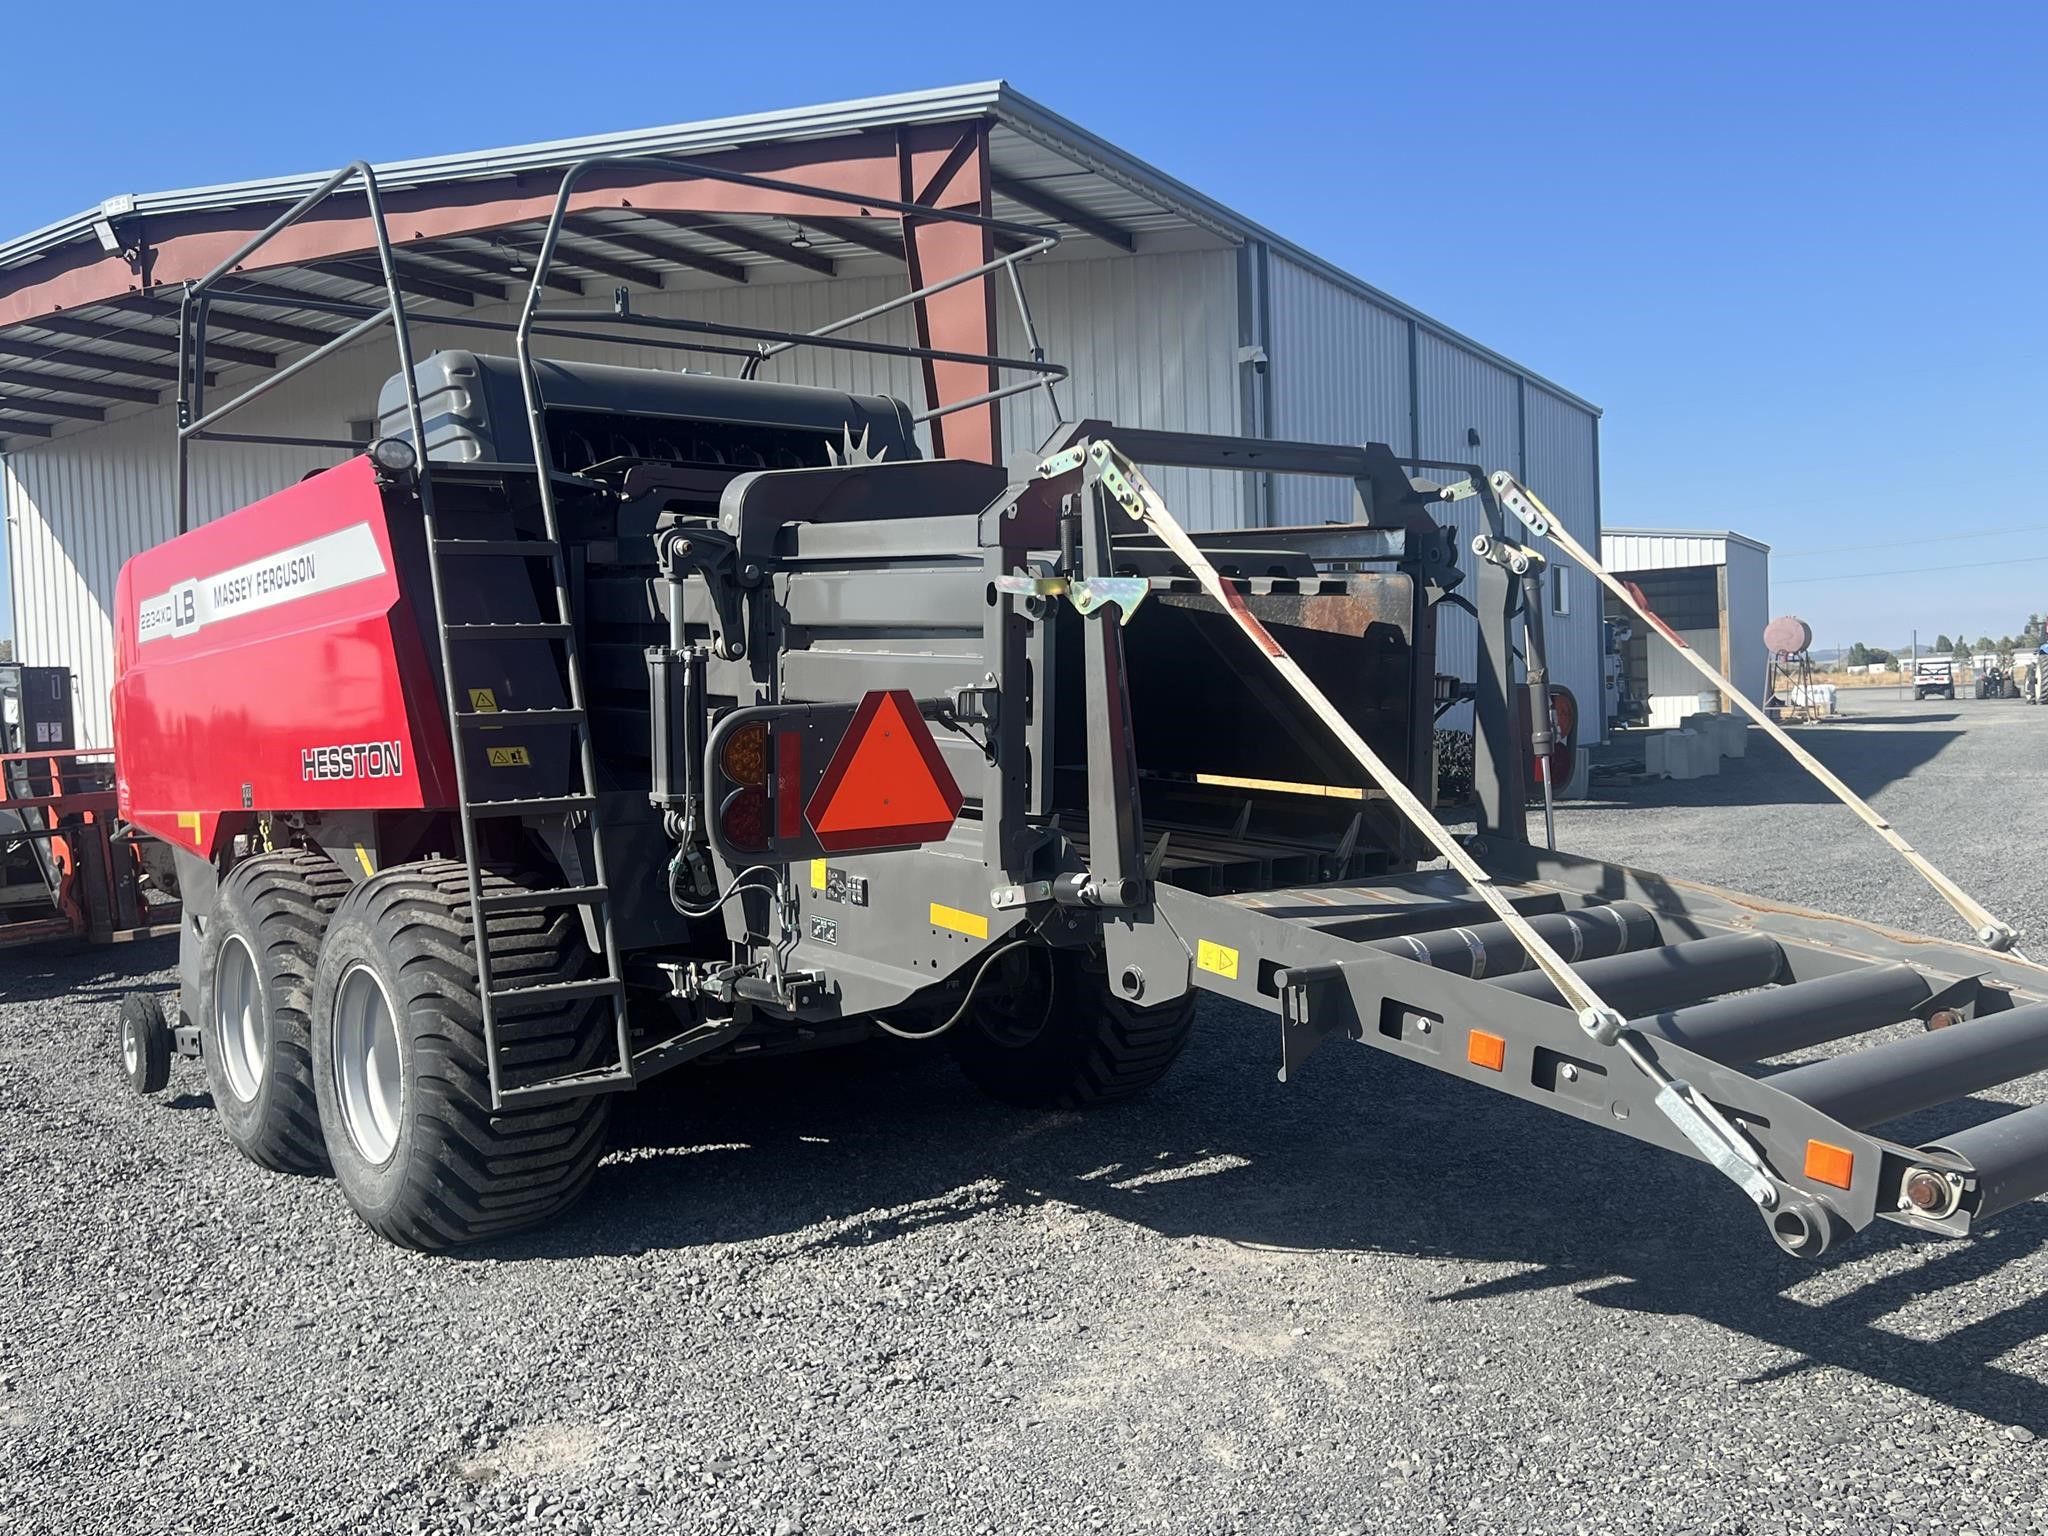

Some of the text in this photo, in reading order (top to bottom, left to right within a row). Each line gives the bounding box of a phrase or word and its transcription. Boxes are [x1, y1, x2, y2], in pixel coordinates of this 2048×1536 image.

[174, 589, 195, 628] LB
[213, 574, 252, 609] MASSEY
[256, 554, 316, 597] FERGUSON
[302, 742, 402, 780] HESSTON
